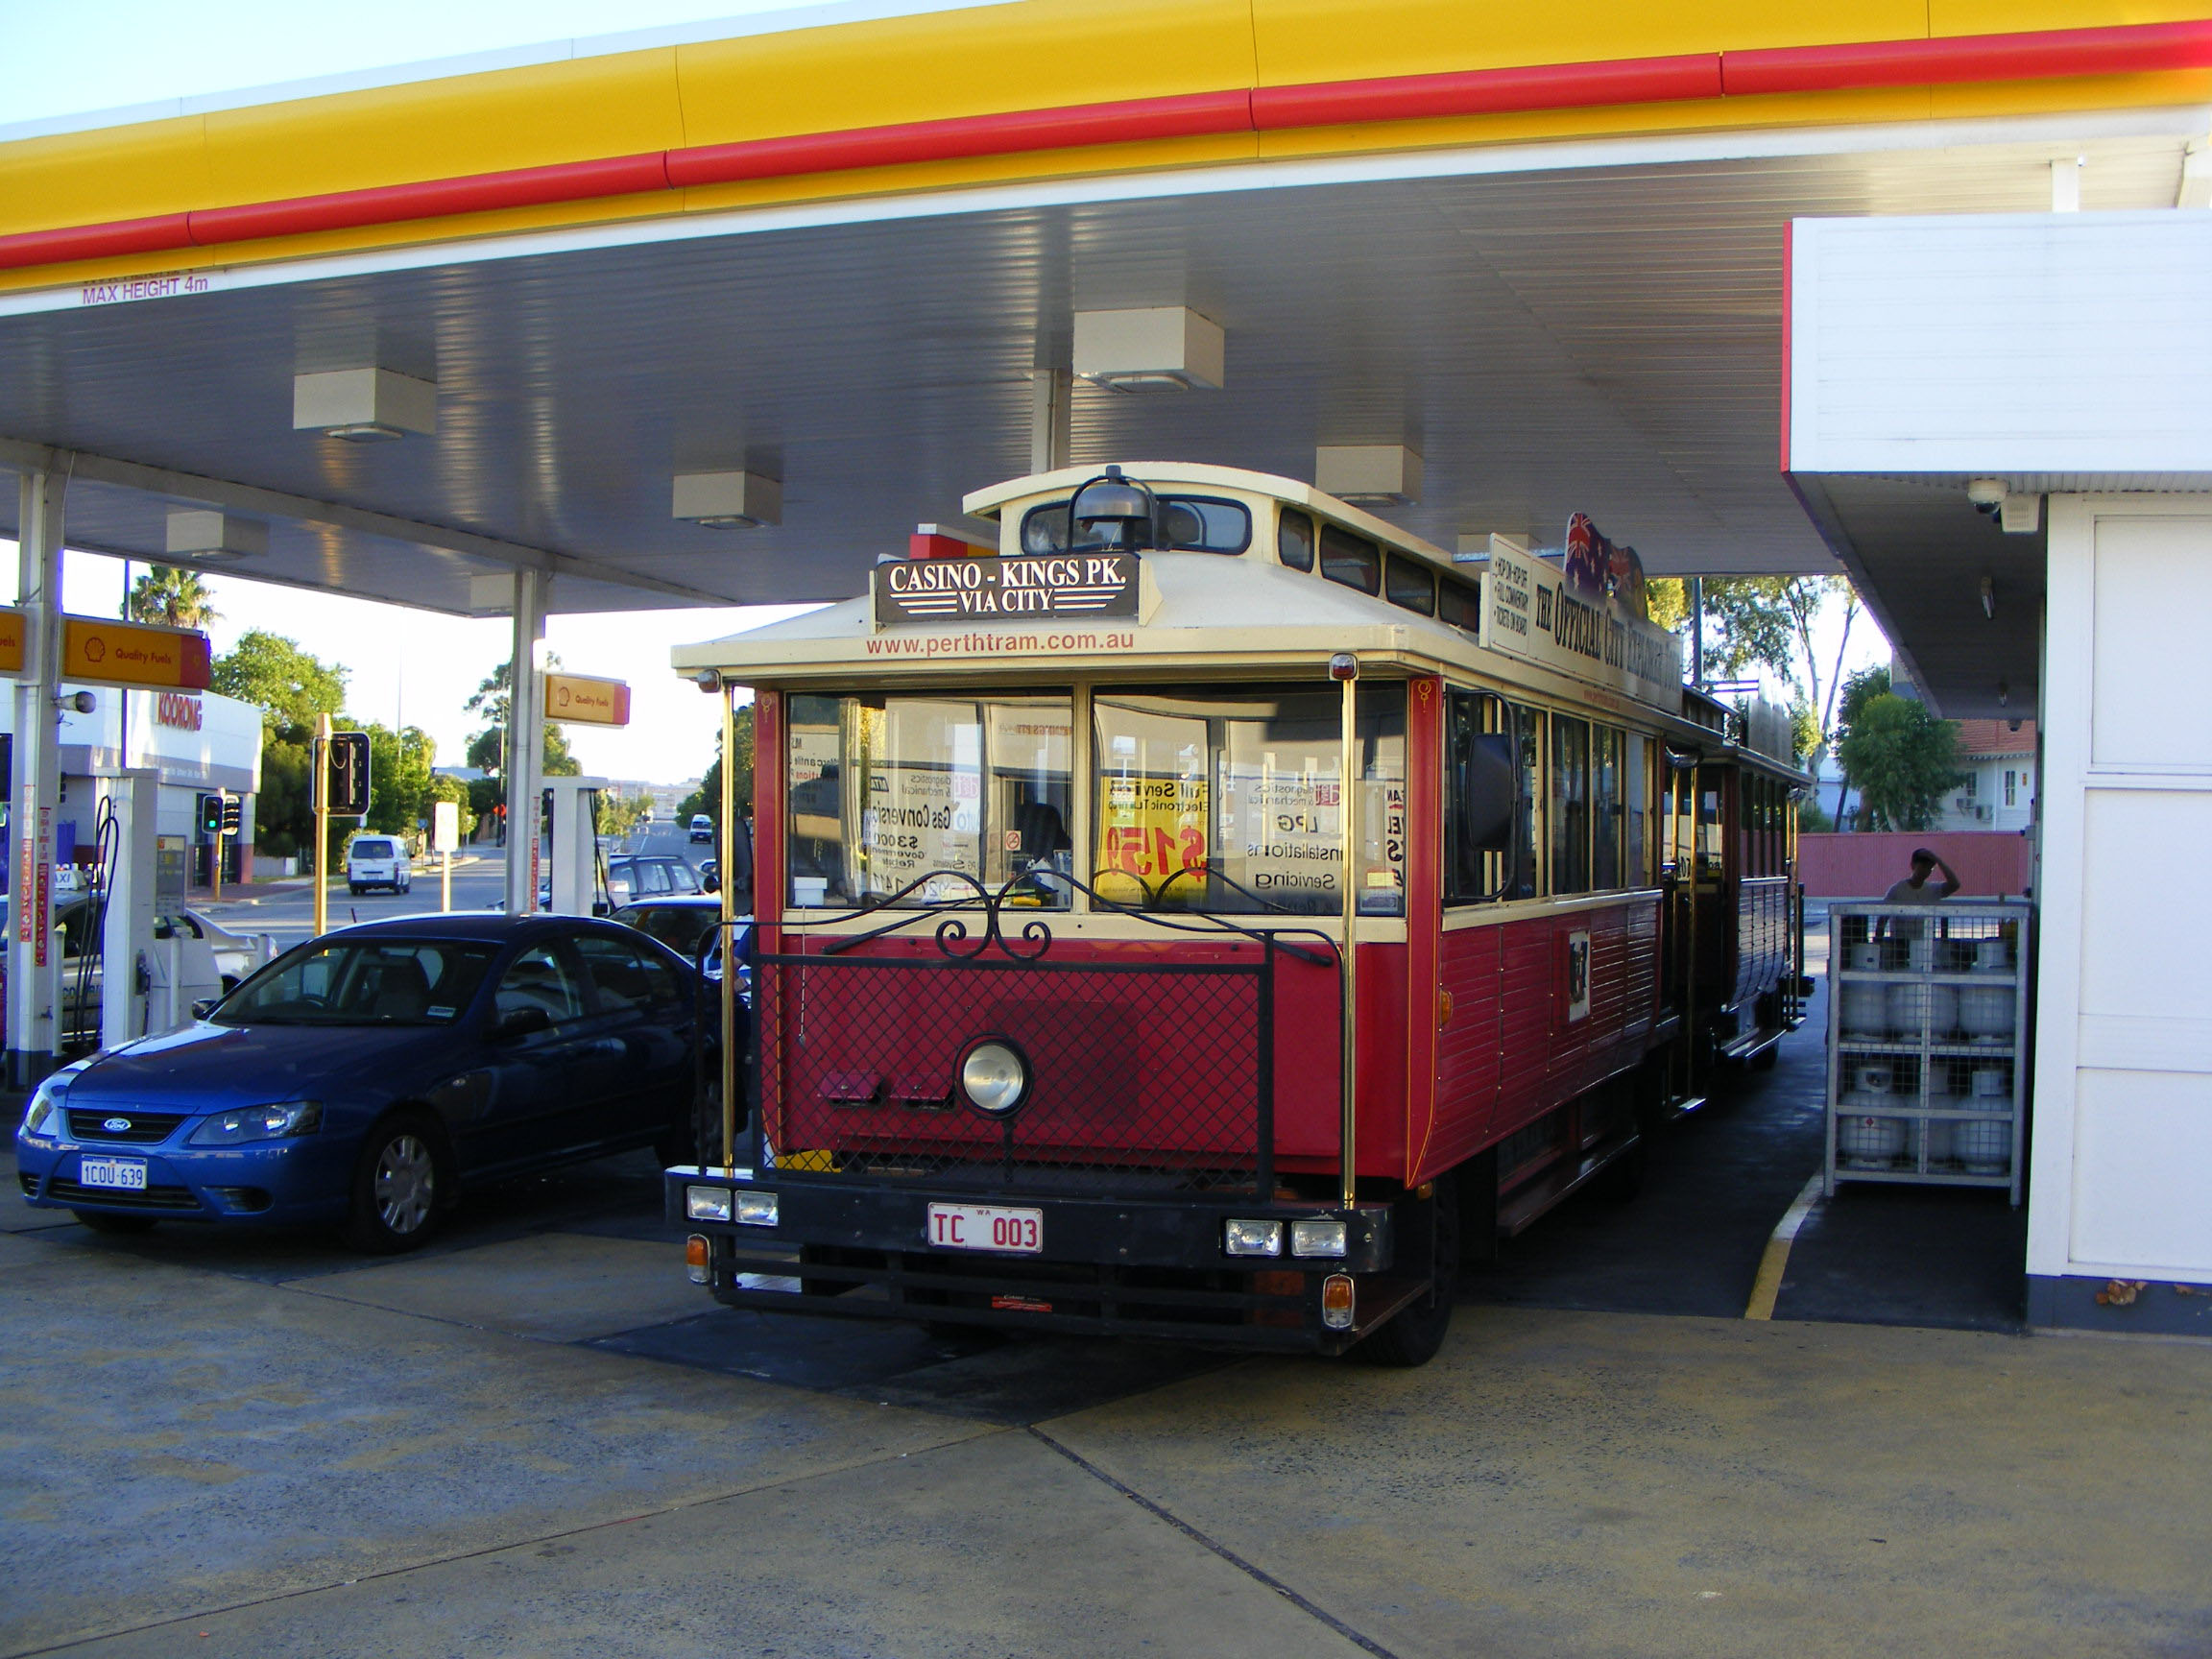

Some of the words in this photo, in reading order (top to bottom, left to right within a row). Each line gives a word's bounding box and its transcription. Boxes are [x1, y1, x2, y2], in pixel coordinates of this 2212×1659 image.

[83, 284, 118, 304] MAX
[123, 276, 180, 301] HEIGHT
[184, 276, 208, 293] 4m
[889, 563, 982, 591] CASINO
[1000, 559, 1080, 588] KINGS
[1086, 557, 1126, 585] PK.
[960, 590, 998, 613] VIA
[1001, 589, 1053, 612] CITY
[1536, 583, 1552, 632] THE
[1554, 581, 1600, 661] OFFICIAL
[115, 648, 148, 664] Quality
[151, 649, 171, 664] Fuels
[866, 633, 1134, 658] www.perthtram.com.au
[157, 692, 203, 732] KOORONG
[576, 695, 594, 707] Quality
[934, 1213, 965, 1243] TC
[993, 1216, 1038, 1247] 003
